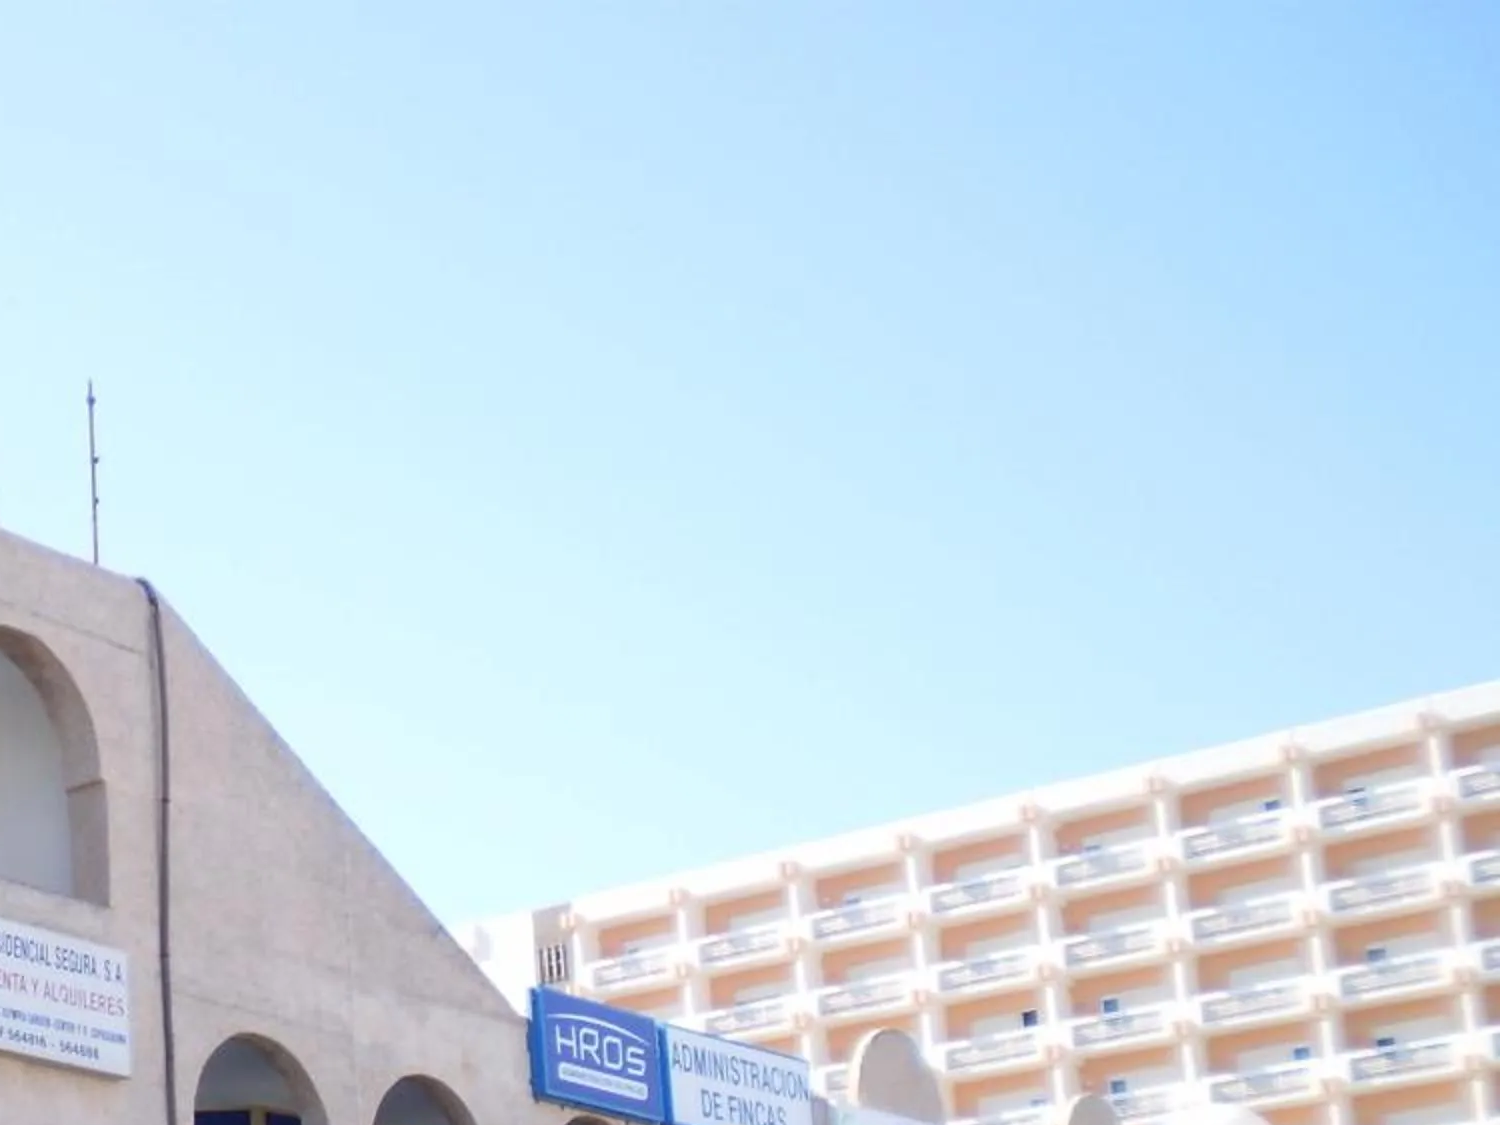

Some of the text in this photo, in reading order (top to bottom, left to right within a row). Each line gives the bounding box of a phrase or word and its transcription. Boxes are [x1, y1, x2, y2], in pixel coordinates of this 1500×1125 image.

[54, 945, 98, 976] SEGURA
[29, 977, 40, 994] Y
[42, 978, 126, 1017] ALQUILERES
[554, 1024, 646, 1077] HROS
[672, 1040, 811, 1102] ADMINISTRACION
[700, 1089, 725, 1121] DE
